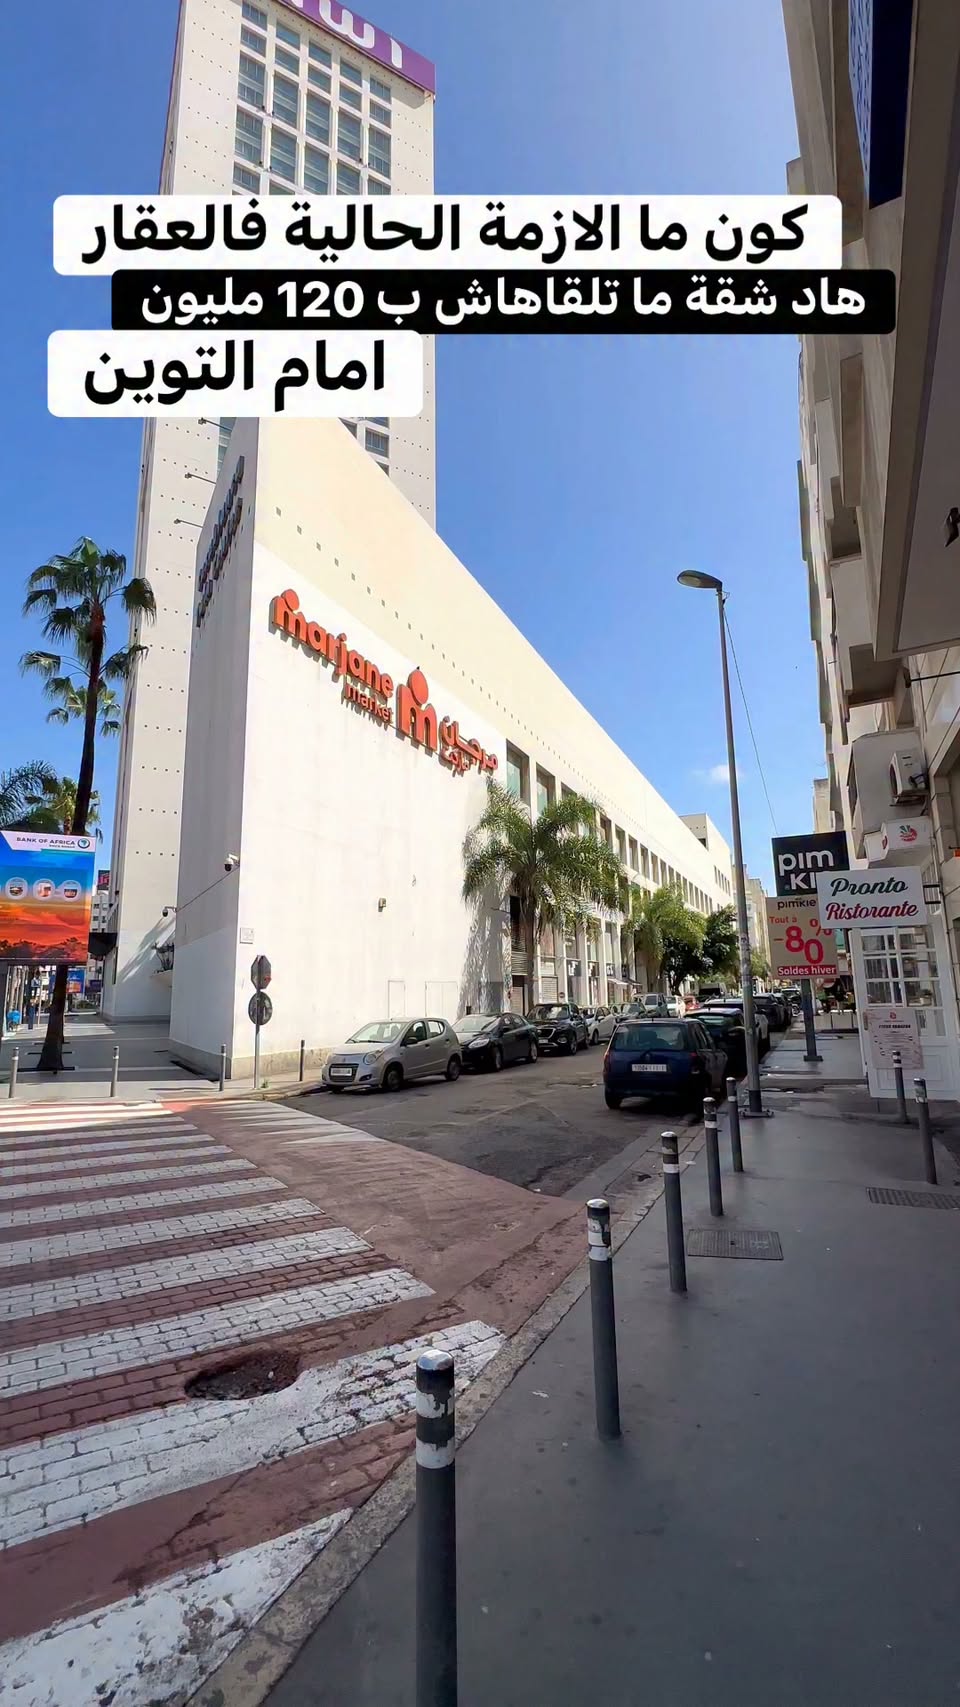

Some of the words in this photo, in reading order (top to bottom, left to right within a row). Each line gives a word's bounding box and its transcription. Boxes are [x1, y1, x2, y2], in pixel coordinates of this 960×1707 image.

[271, 589, 394, 699] marjane
[345, 683, 394, 723] market
[830, 876, 909, 897] Pronto
[769, 917, 790, 925] Tout
[825, 900, 919, 921] Ristorante
[778, 966, 809, 976] Soldes
[811, 964, 836, 974] hiver
